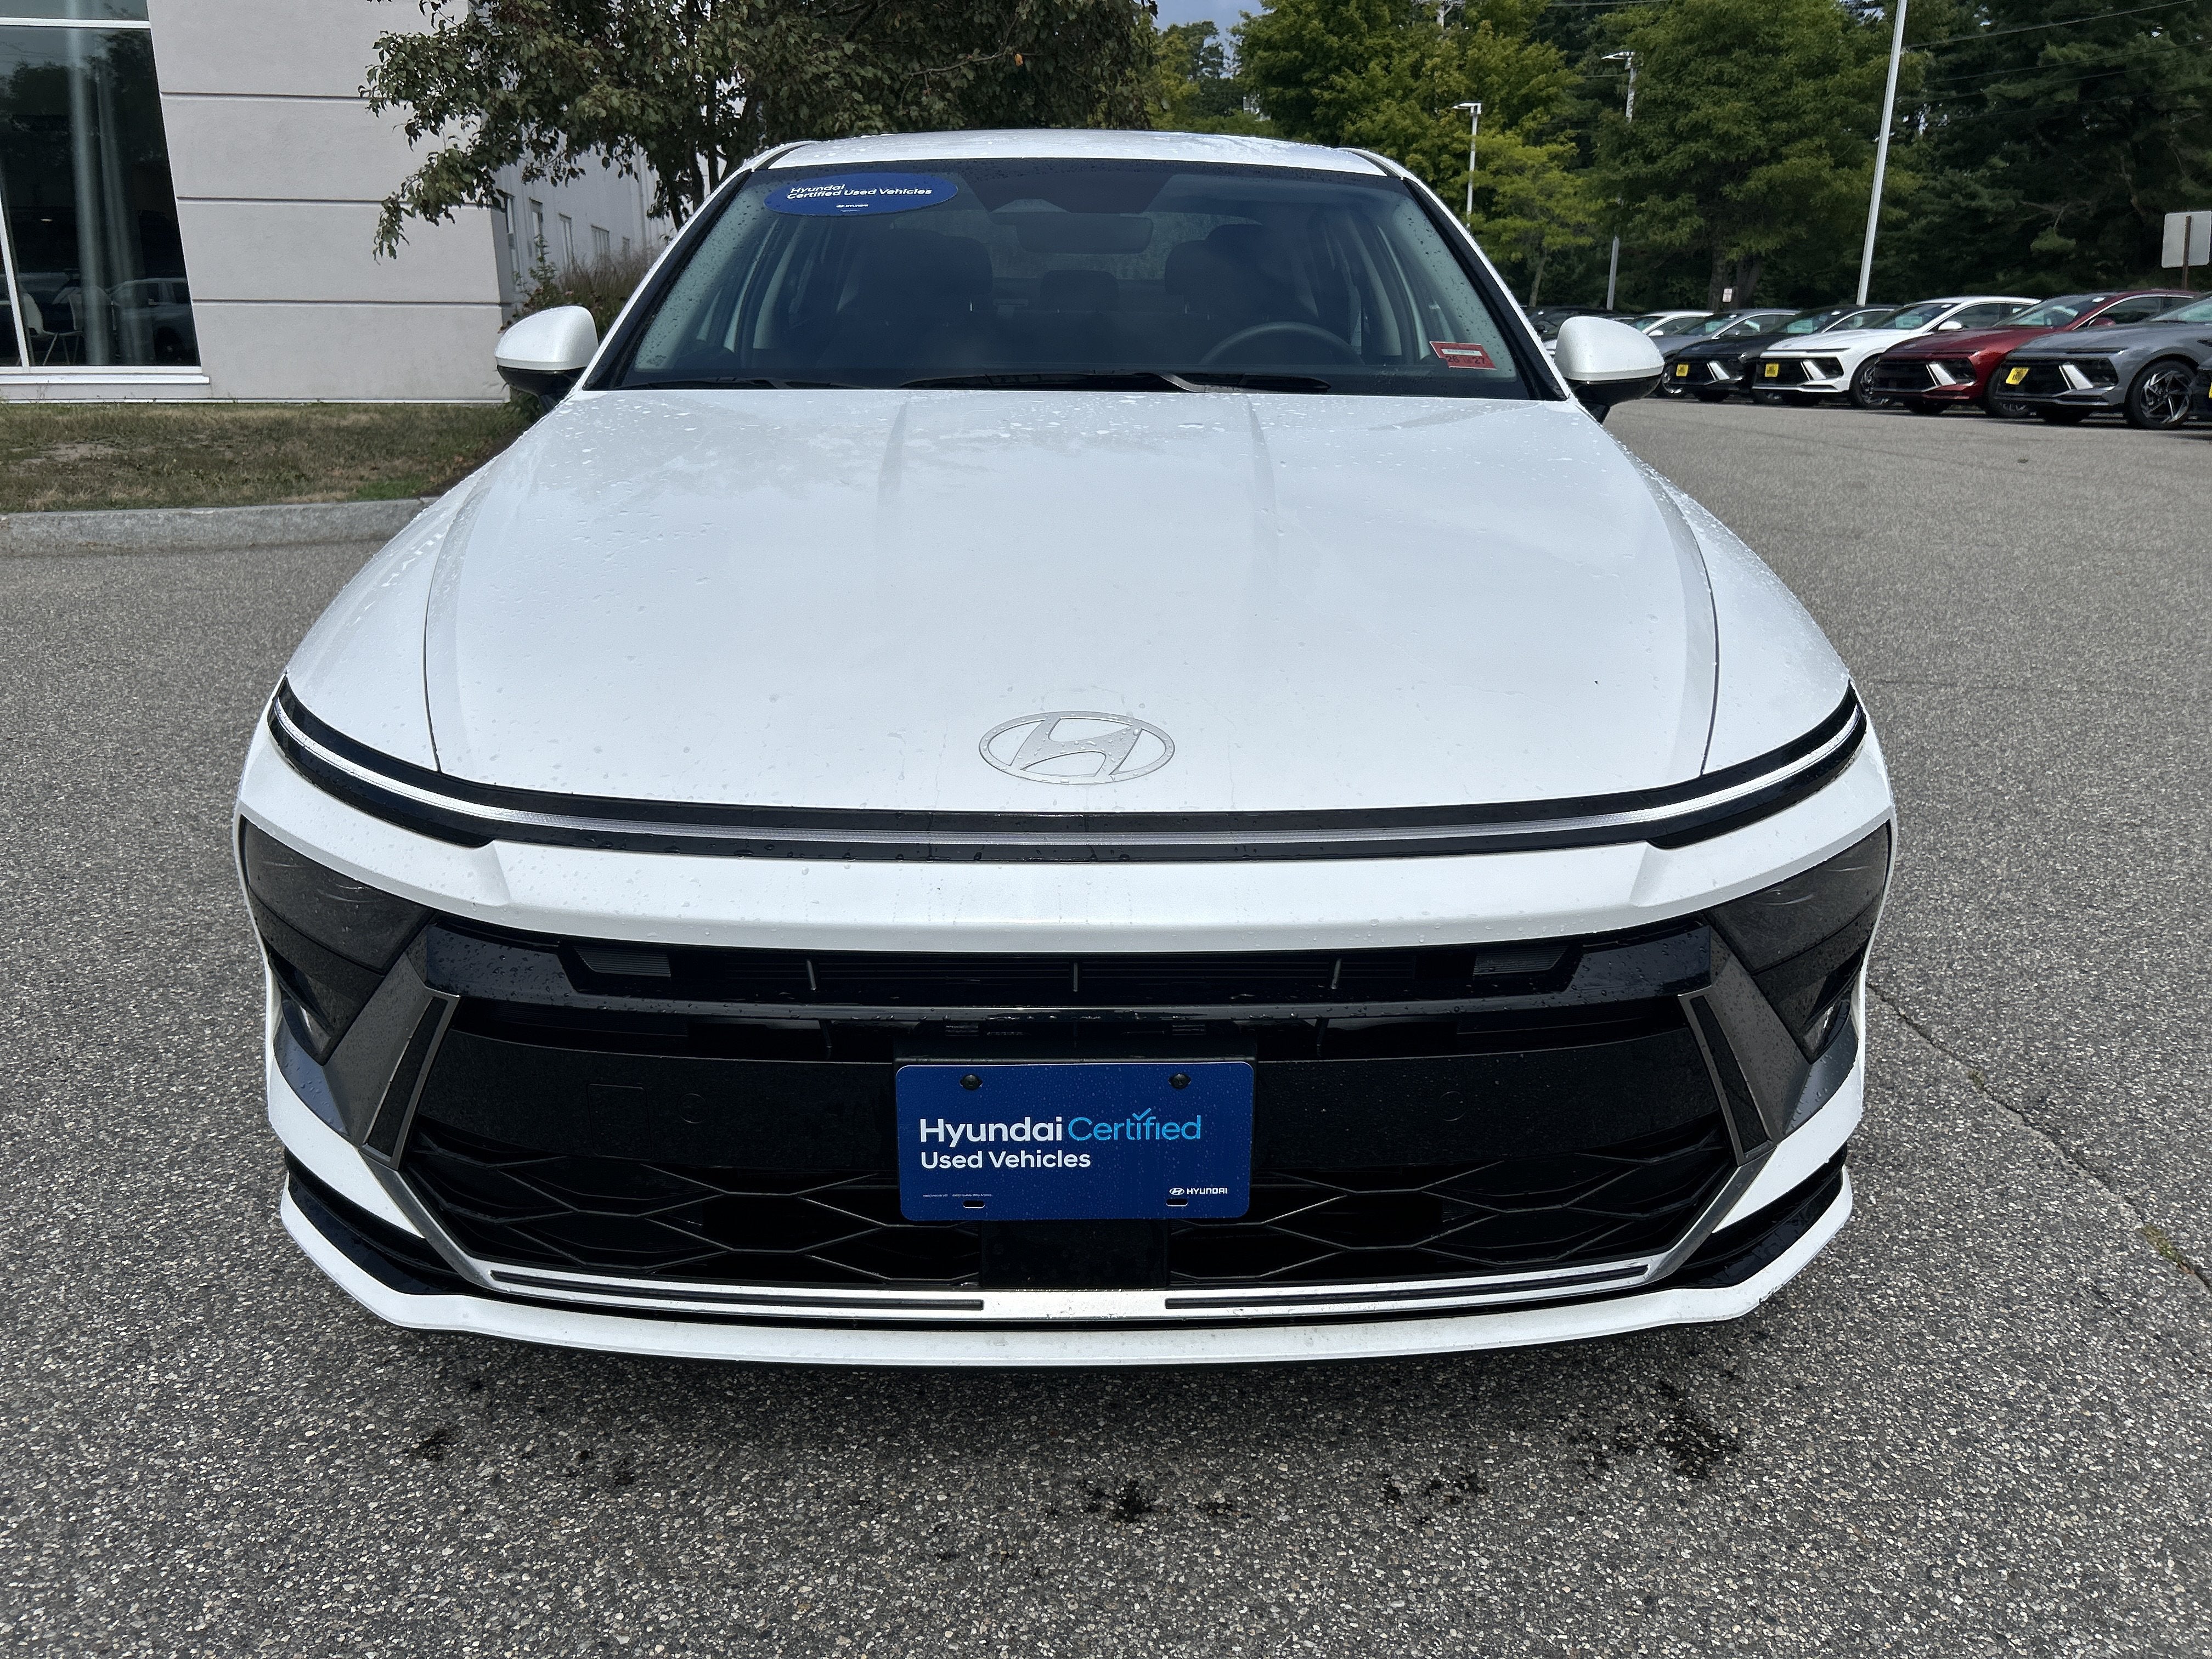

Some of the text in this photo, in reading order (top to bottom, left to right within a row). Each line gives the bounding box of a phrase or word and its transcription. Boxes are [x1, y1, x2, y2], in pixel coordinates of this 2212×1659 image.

[787, 190, 842, 199] Certified
[790, 184, 845, 194] Hyundai
[919, 1108, 1201, 1148] Hyundai Certified
[921, 1149, 1091, 1170] Used Vehicles
